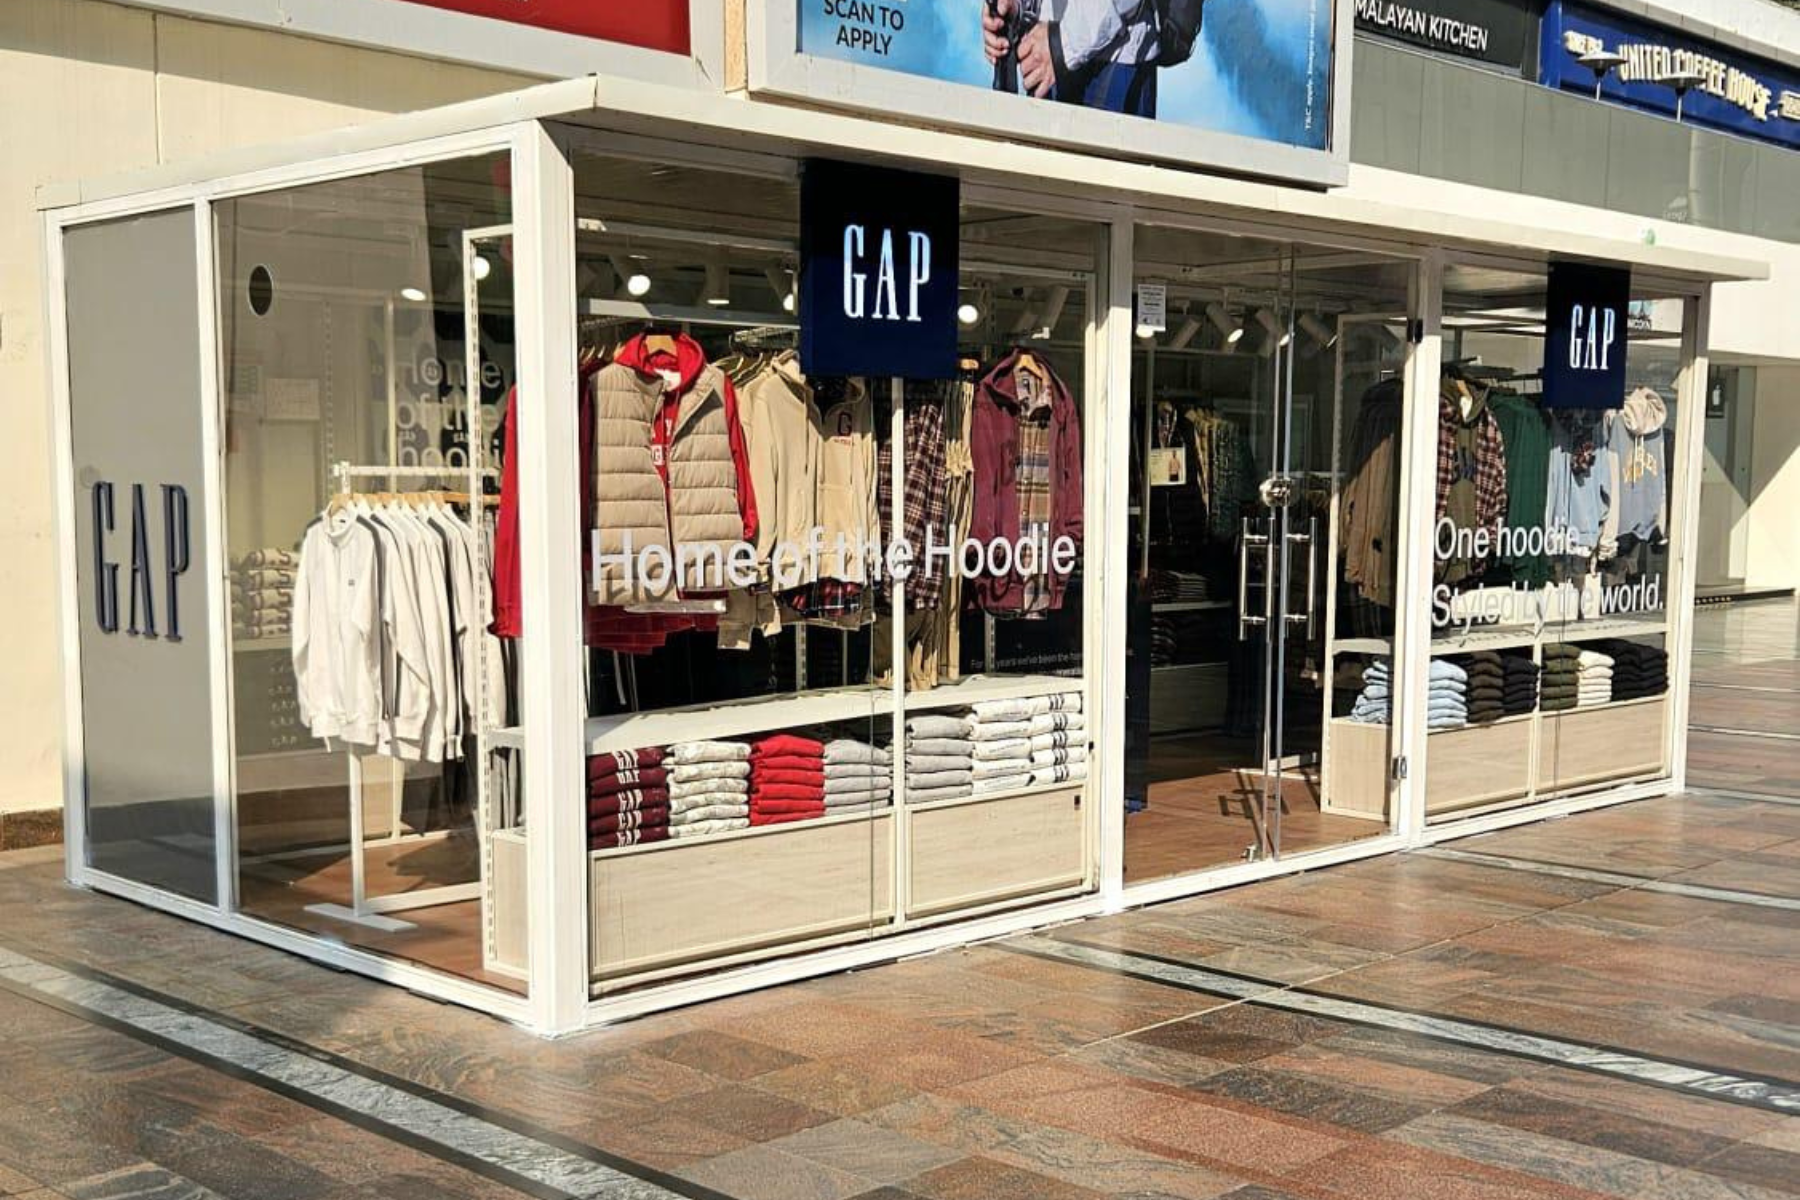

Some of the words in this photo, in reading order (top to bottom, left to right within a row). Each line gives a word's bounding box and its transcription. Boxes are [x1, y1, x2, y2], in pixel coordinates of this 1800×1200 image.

[823, 0, 875, 25] SCAN
[879, 6, 904, 31] TO
[836, 24, 893, 56] APPLY
[1355, 0, 1427, 35] MALAYAN
[1429, 15, 1489, 51] KITCHEN
[1618, 44, 1671, 81] UNITED
[1673, 49, 1726, 97] COFFEE
[1727, 67, 1771, 121] HOUSE
[843, 224, 932, 322] GAP
[1569, 304, 1616, 370] GAP
[92, 481, 190, 643] GAP
[591, 529, 757, 592] Home
[771, 525, 823, 592] of
[834, 525, 913, 584] the
[925, 521, 1077, 580] Hoodie
[1434, 517, 1490, 560] One
[1432, 580, 1516, 635] Styled
[1523, 580, 1550, 636] by
[1557, 577, 1595, 619] the
[1600, 573, 1664, 615] world.
